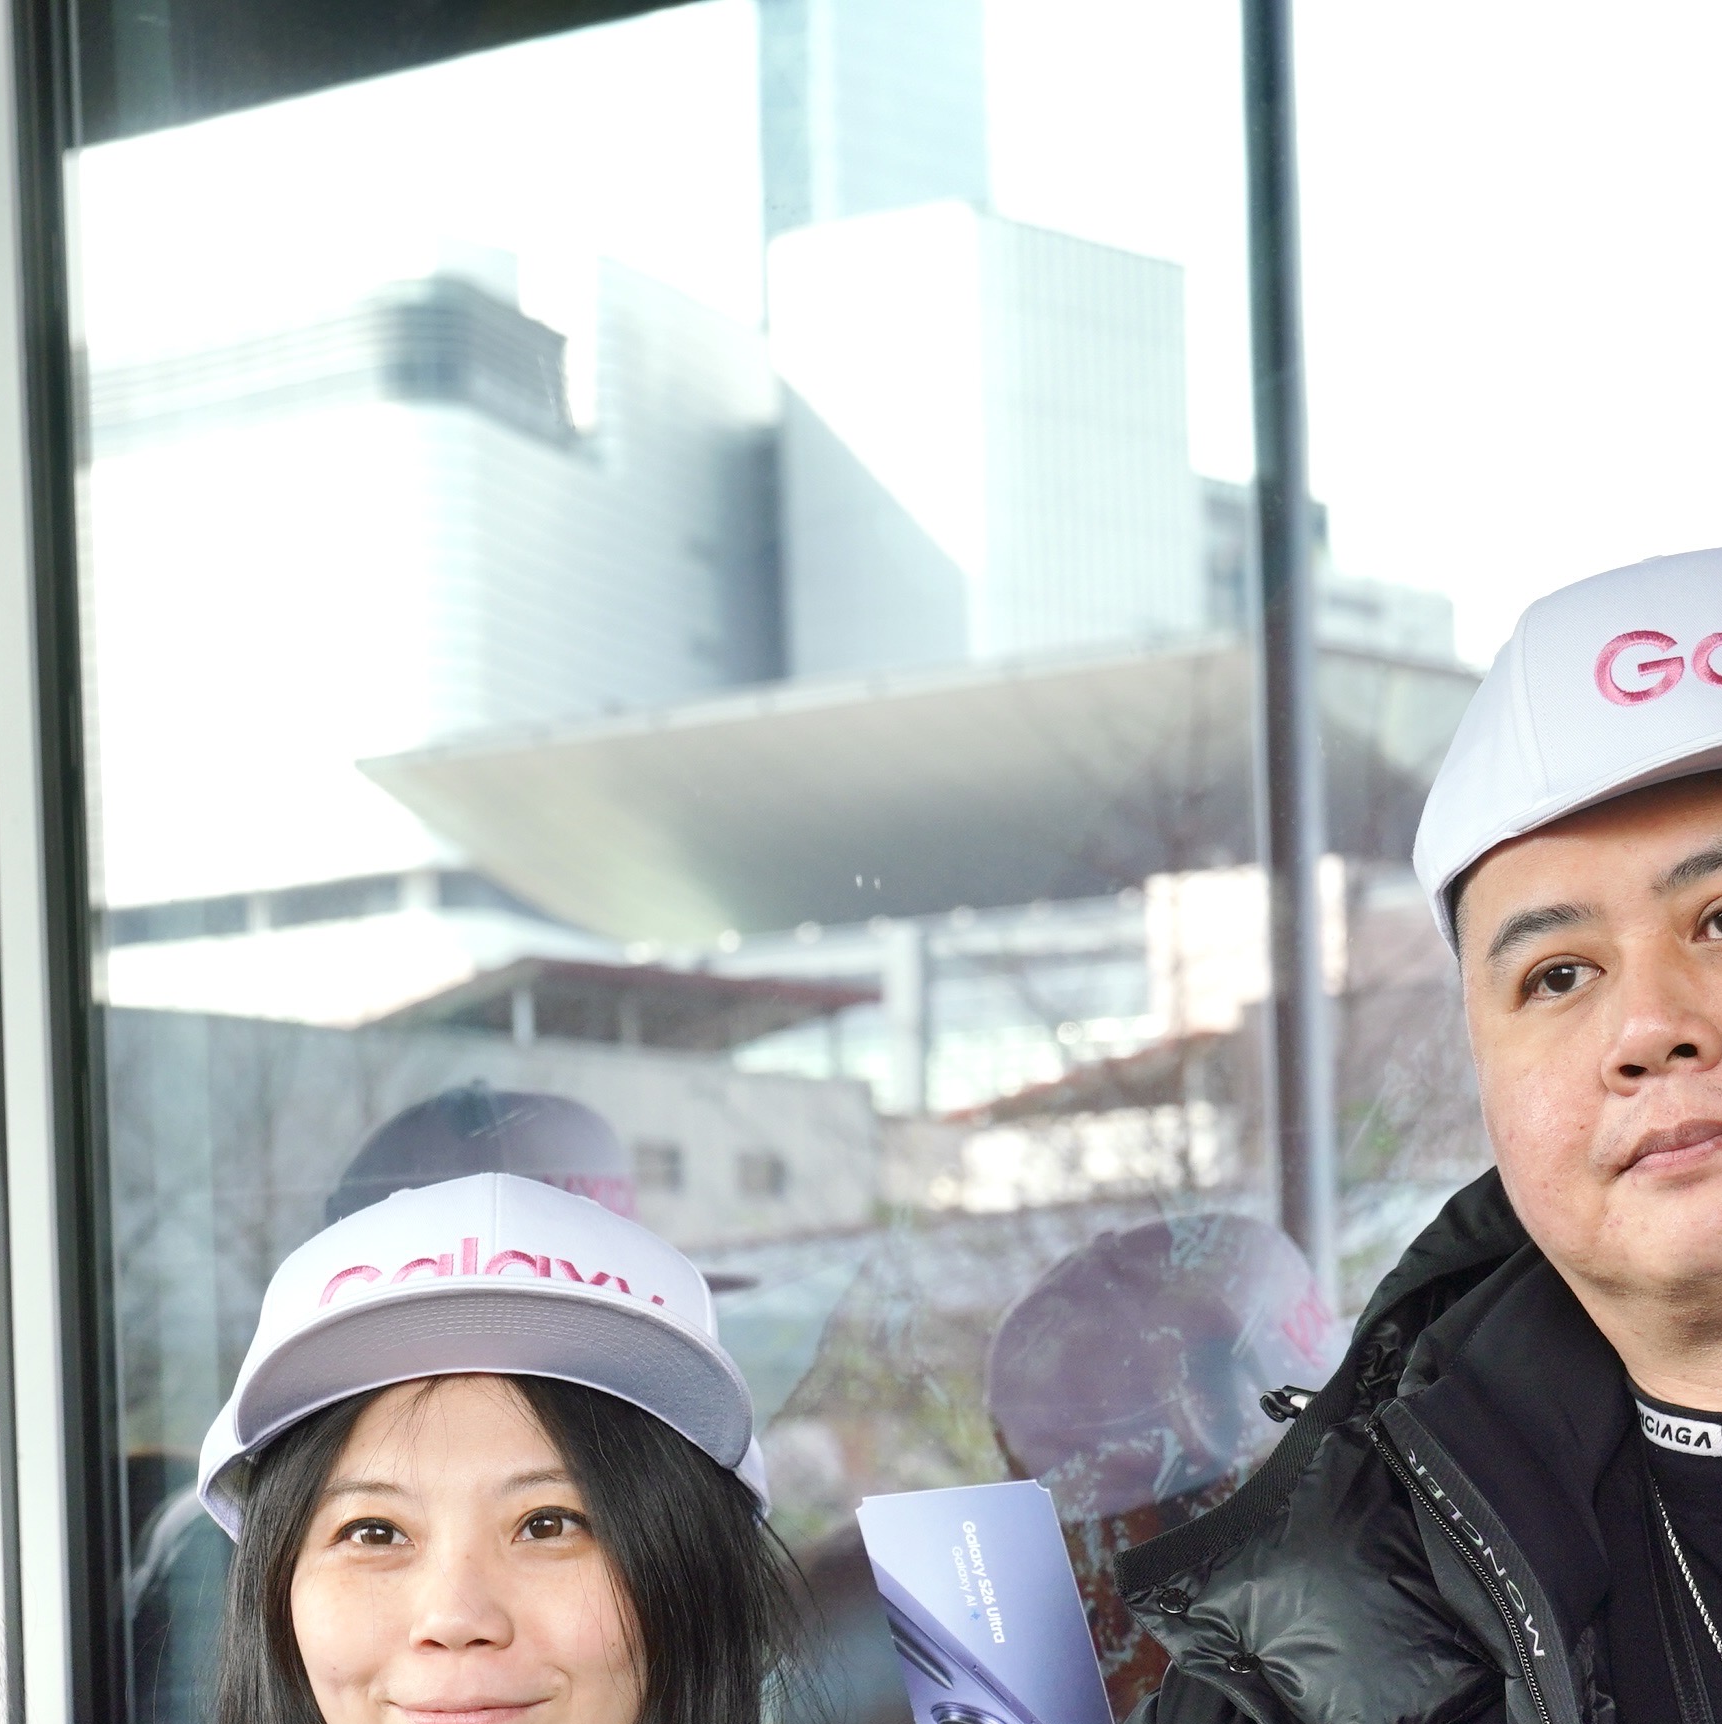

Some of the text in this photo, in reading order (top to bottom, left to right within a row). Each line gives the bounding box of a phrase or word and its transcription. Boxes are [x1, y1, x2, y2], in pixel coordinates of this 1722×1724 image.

[952, 1545, 973, 1592] Galaxy
[962, 1520, 1005, 1644] Galaxy S26 Ultra
[1408, 1448, 1545, 1657] MONCLER
